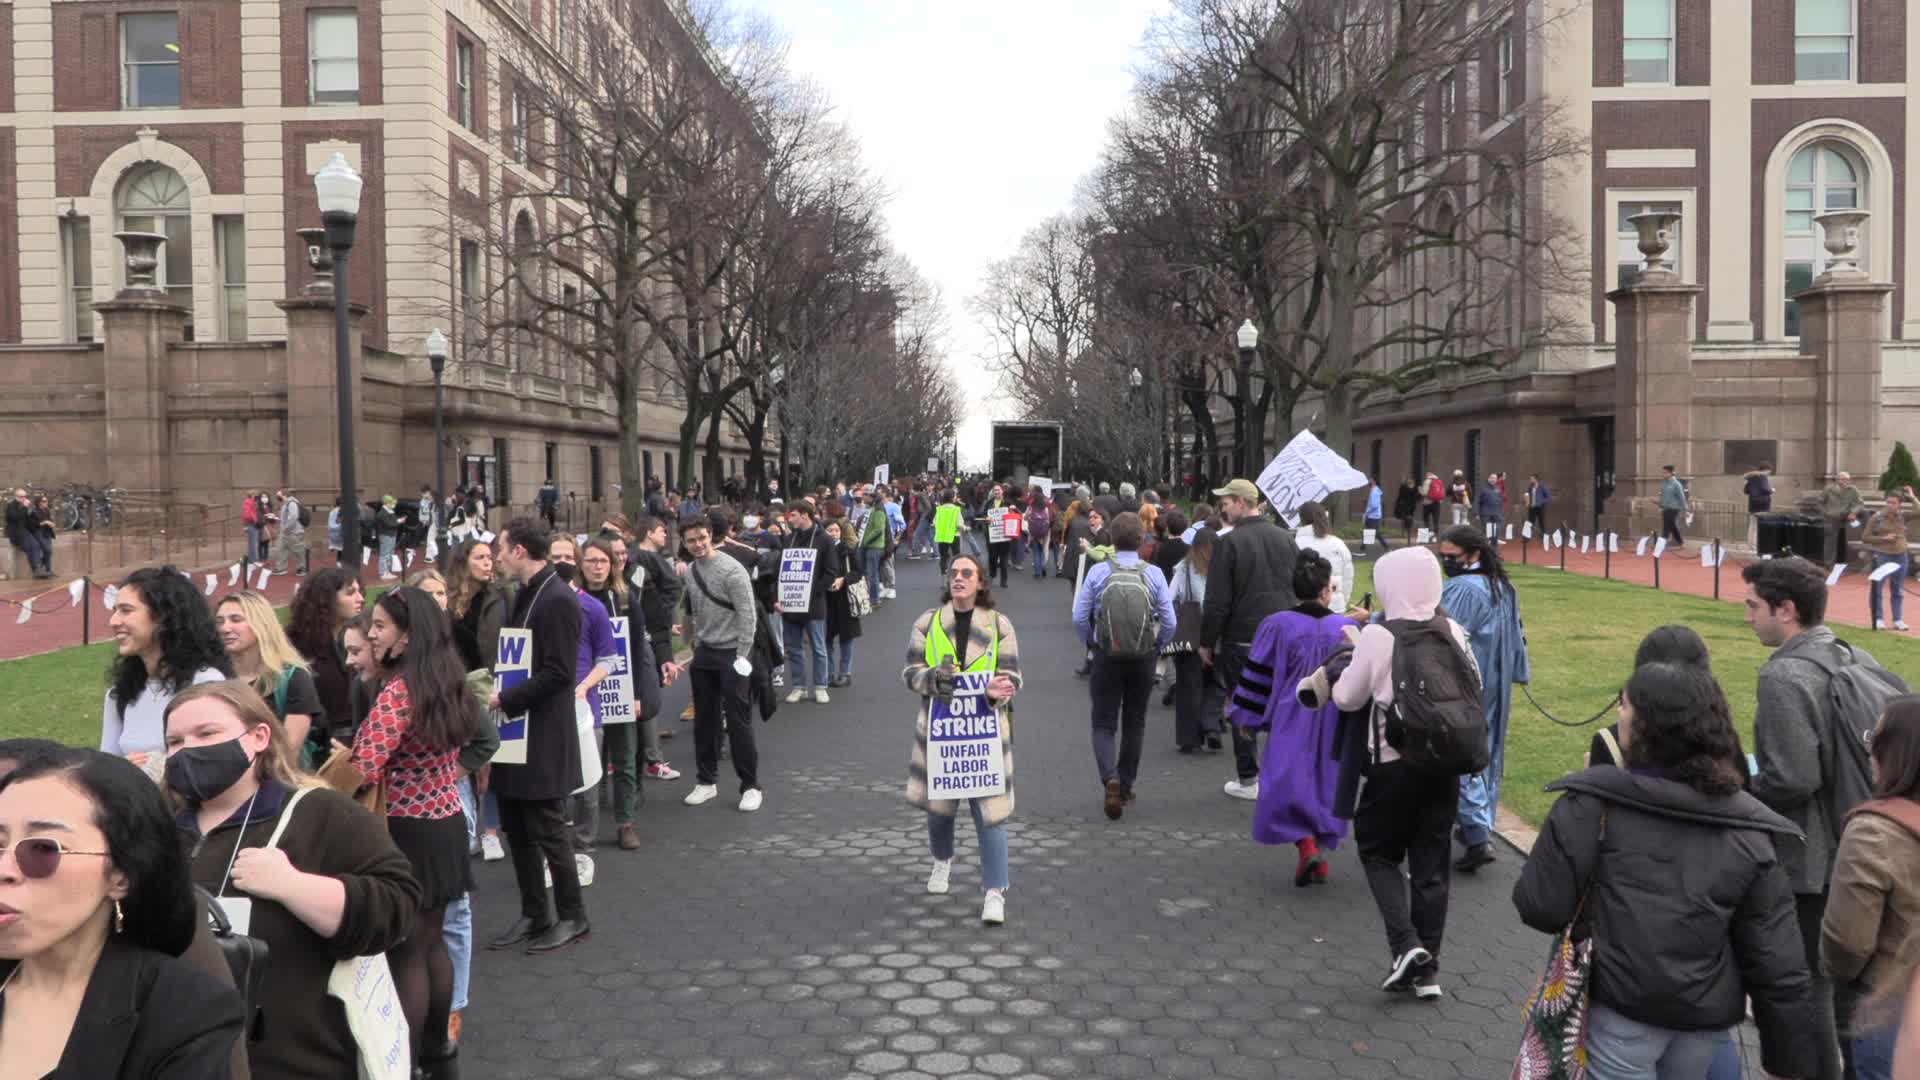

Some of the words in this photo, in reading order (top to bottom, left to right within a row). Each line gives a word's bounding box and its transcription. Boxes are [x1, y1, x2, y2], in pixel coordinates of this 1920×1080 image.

[785, 550, 813, 559] UAW
[791, 560, 804, 571] ON
[781, 572, 810, 581] STRIKE
[783, 584, 804, 592] UNFAIR
[783, 592, 802, 600] LABOR
[599, 679, 621, 691] AIR
[952, 673, 990, 690] AW
[950, 696, 977, 716] ON
[932, 715, 996, 737] STRIKE
[940, 743, 990, 759] UNFAIR
[943, 759, 989, 774] LABOR
[933, 773, 1000, 790] PRACTICE
